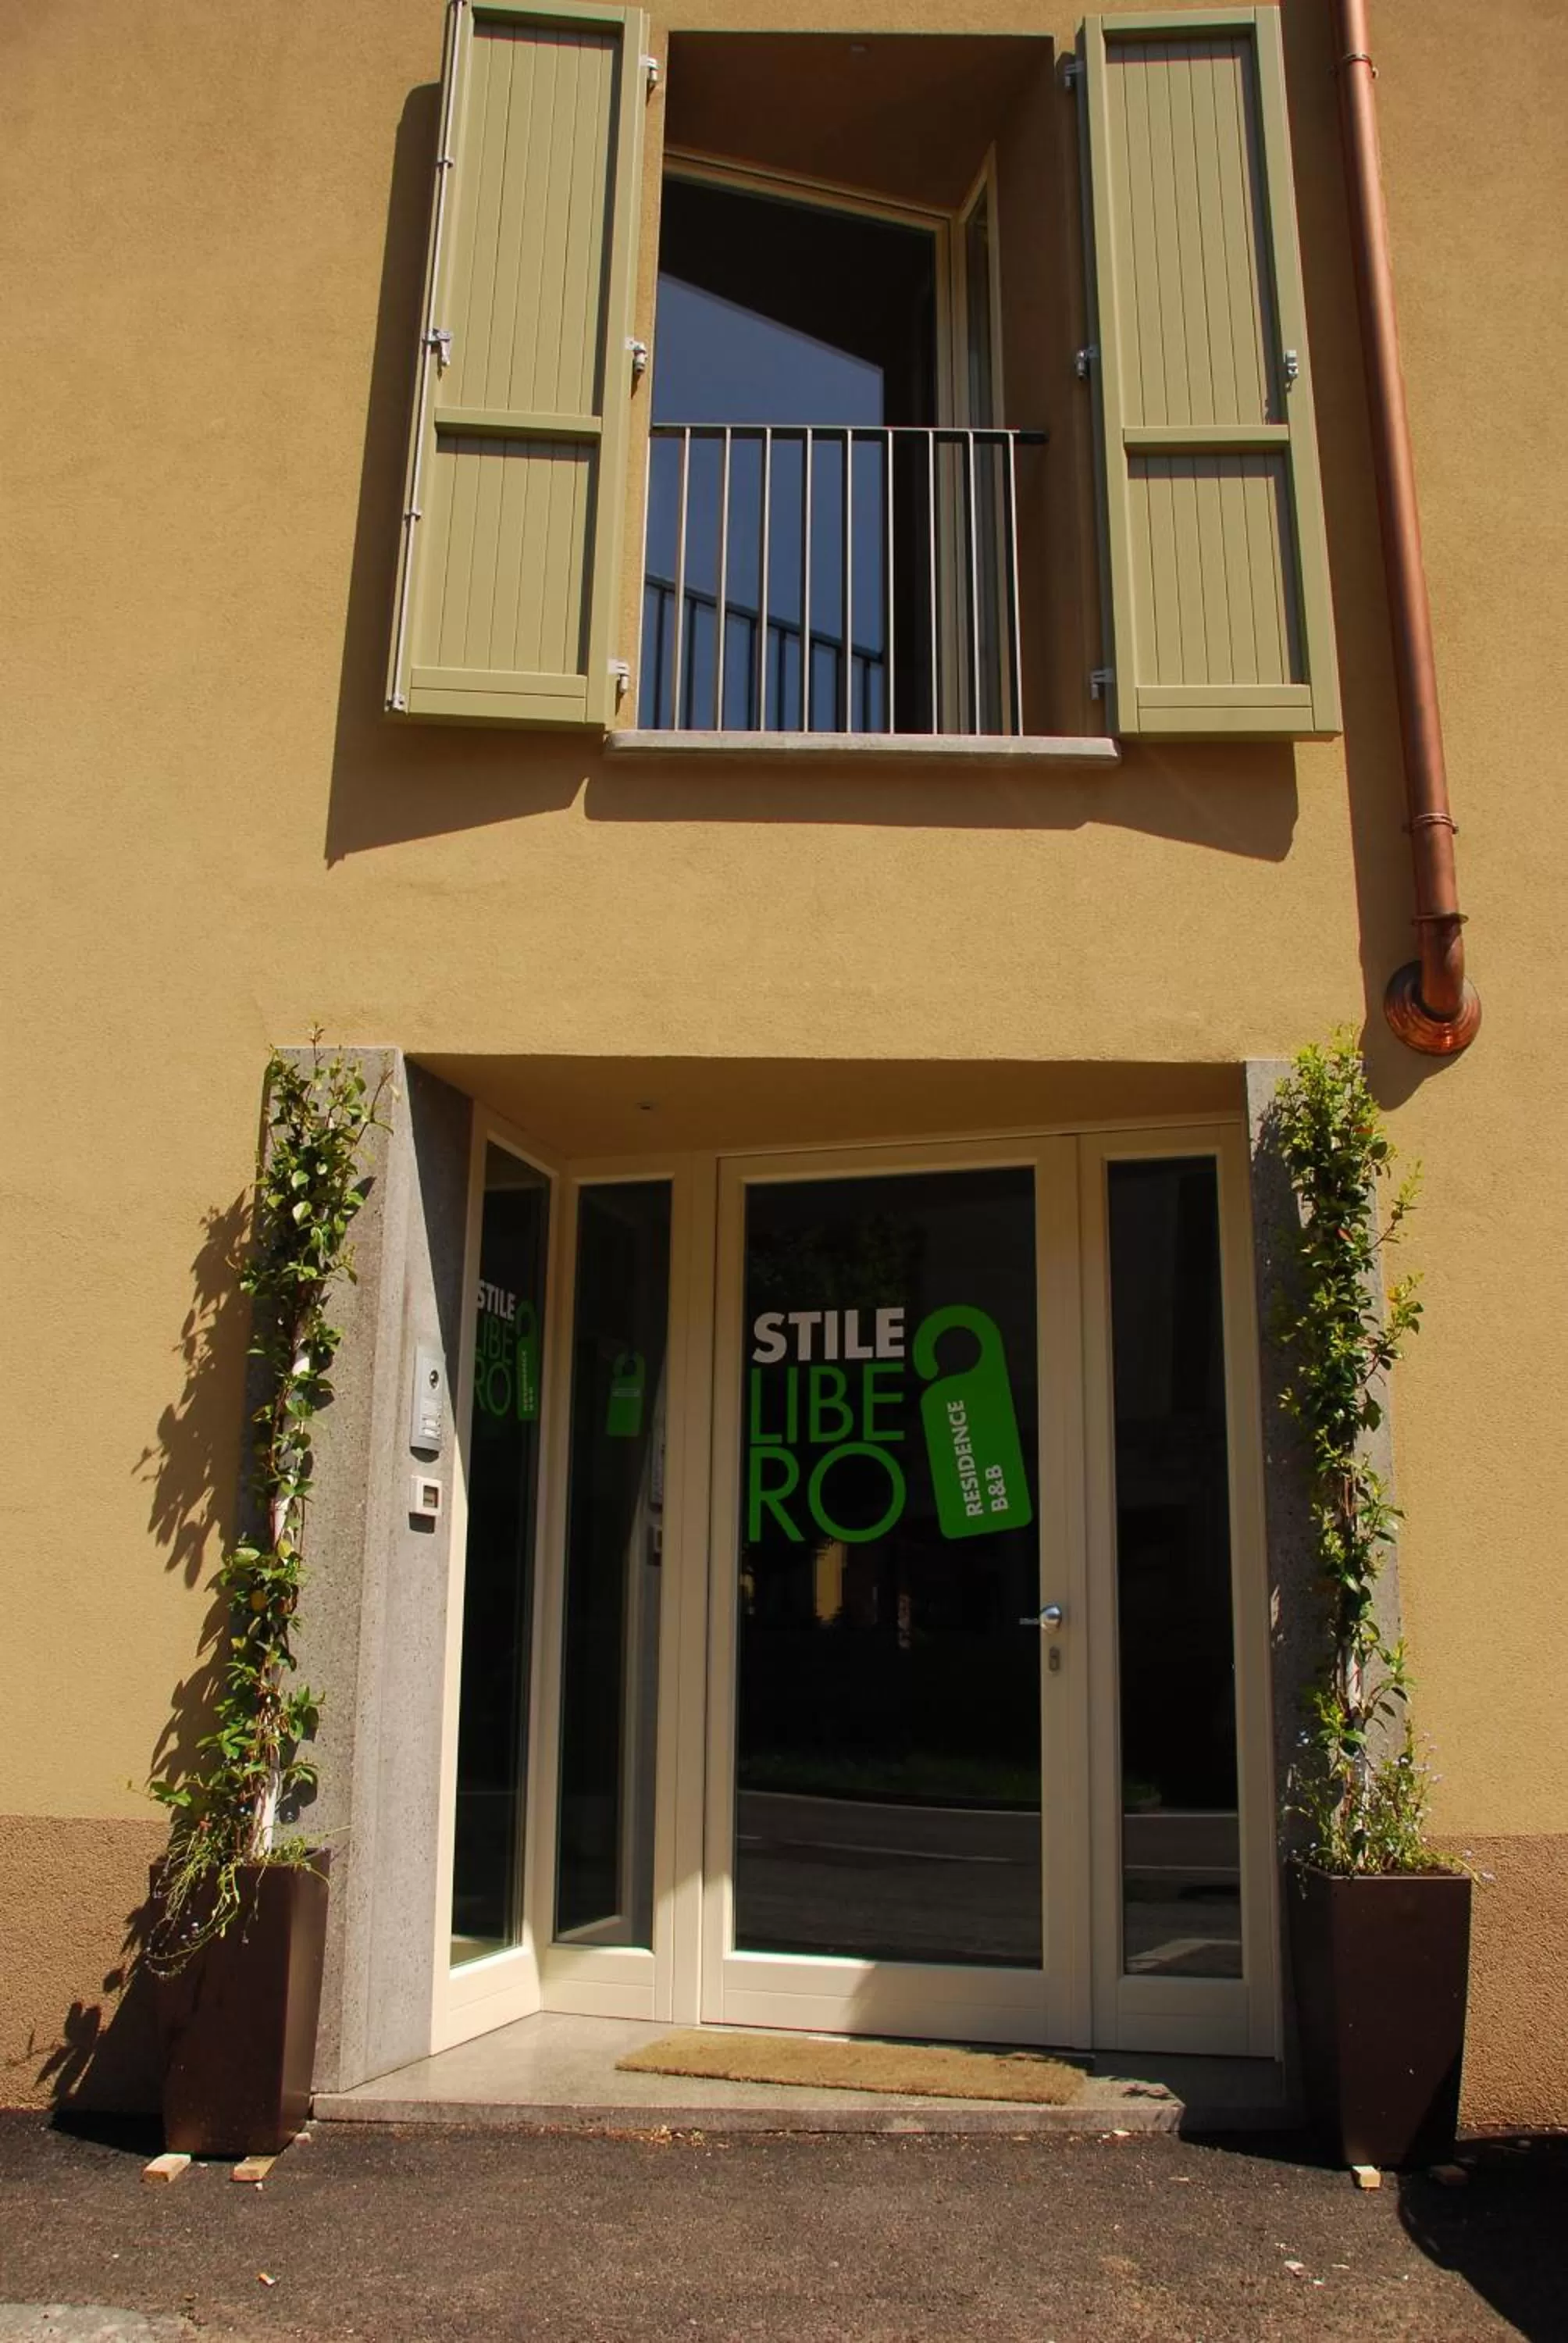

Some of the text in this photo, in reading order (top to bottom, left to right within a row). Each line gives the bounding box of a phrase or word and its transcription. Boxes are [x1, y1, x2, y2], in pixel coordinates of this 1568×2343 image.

[478, 1279, 516, 1321] STILE
[476, 1314, 514, 1366] IBE
[752, 1307, 905, 1364] STILE
[750, 1363, 906, 1444] LIBE
[946, 1400, 984, 1517] RESIDENCE
[748, 1442, 906, 1542] RO
[985, 1464, 1009, 1512] B&B
